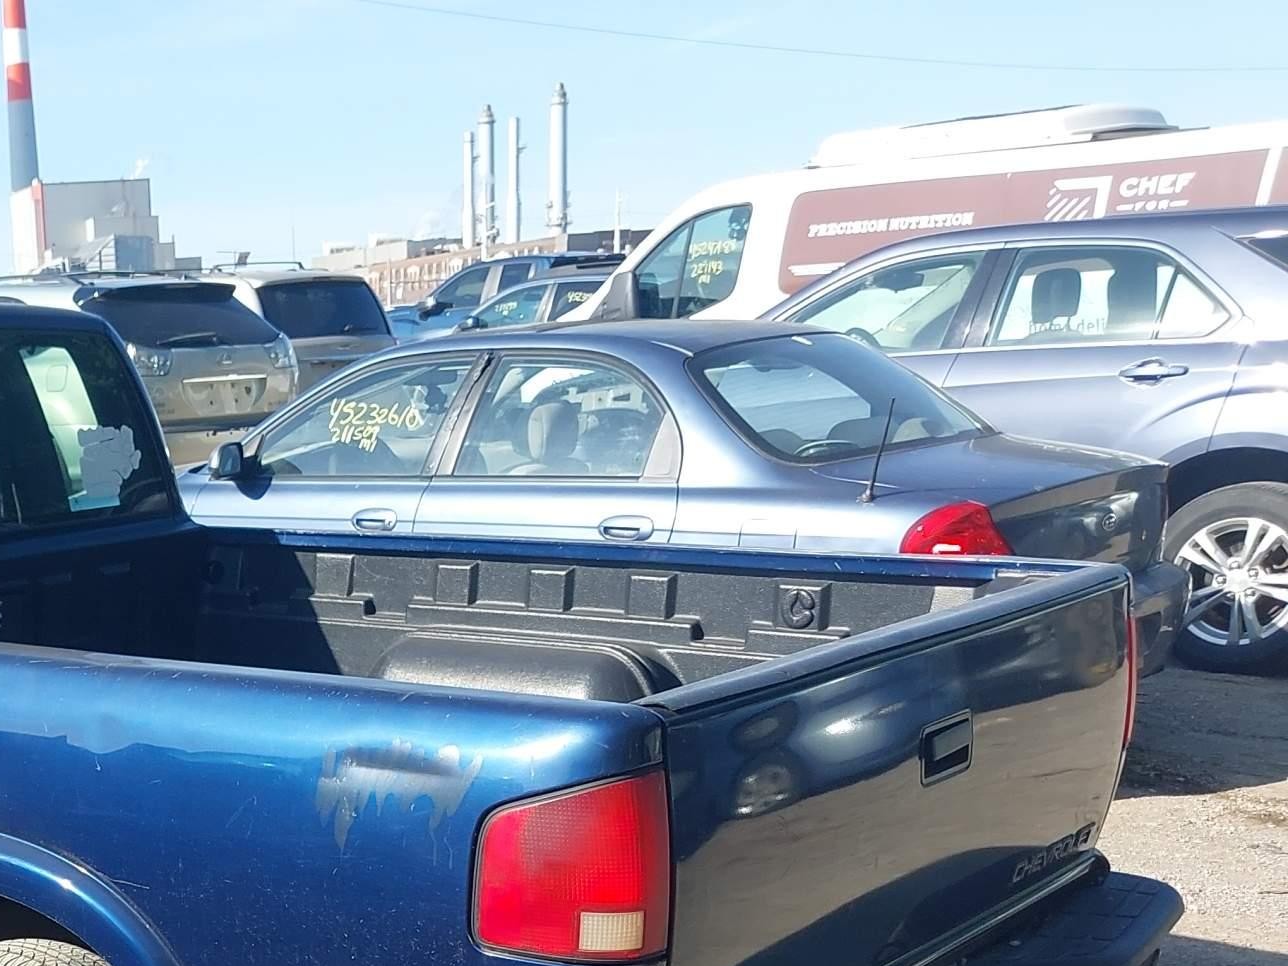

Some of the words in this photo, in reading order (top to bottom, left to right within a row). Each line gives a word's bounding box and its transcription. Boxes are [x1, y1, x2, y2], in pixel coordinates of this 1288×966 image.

[1119, 172, 1196, 198] CHEF
[808, 218, 889, 238] PRECISION
[889, 211, 975, 231] NUTRITION
[1013, 822, 1098, 883] CHEVROLET
